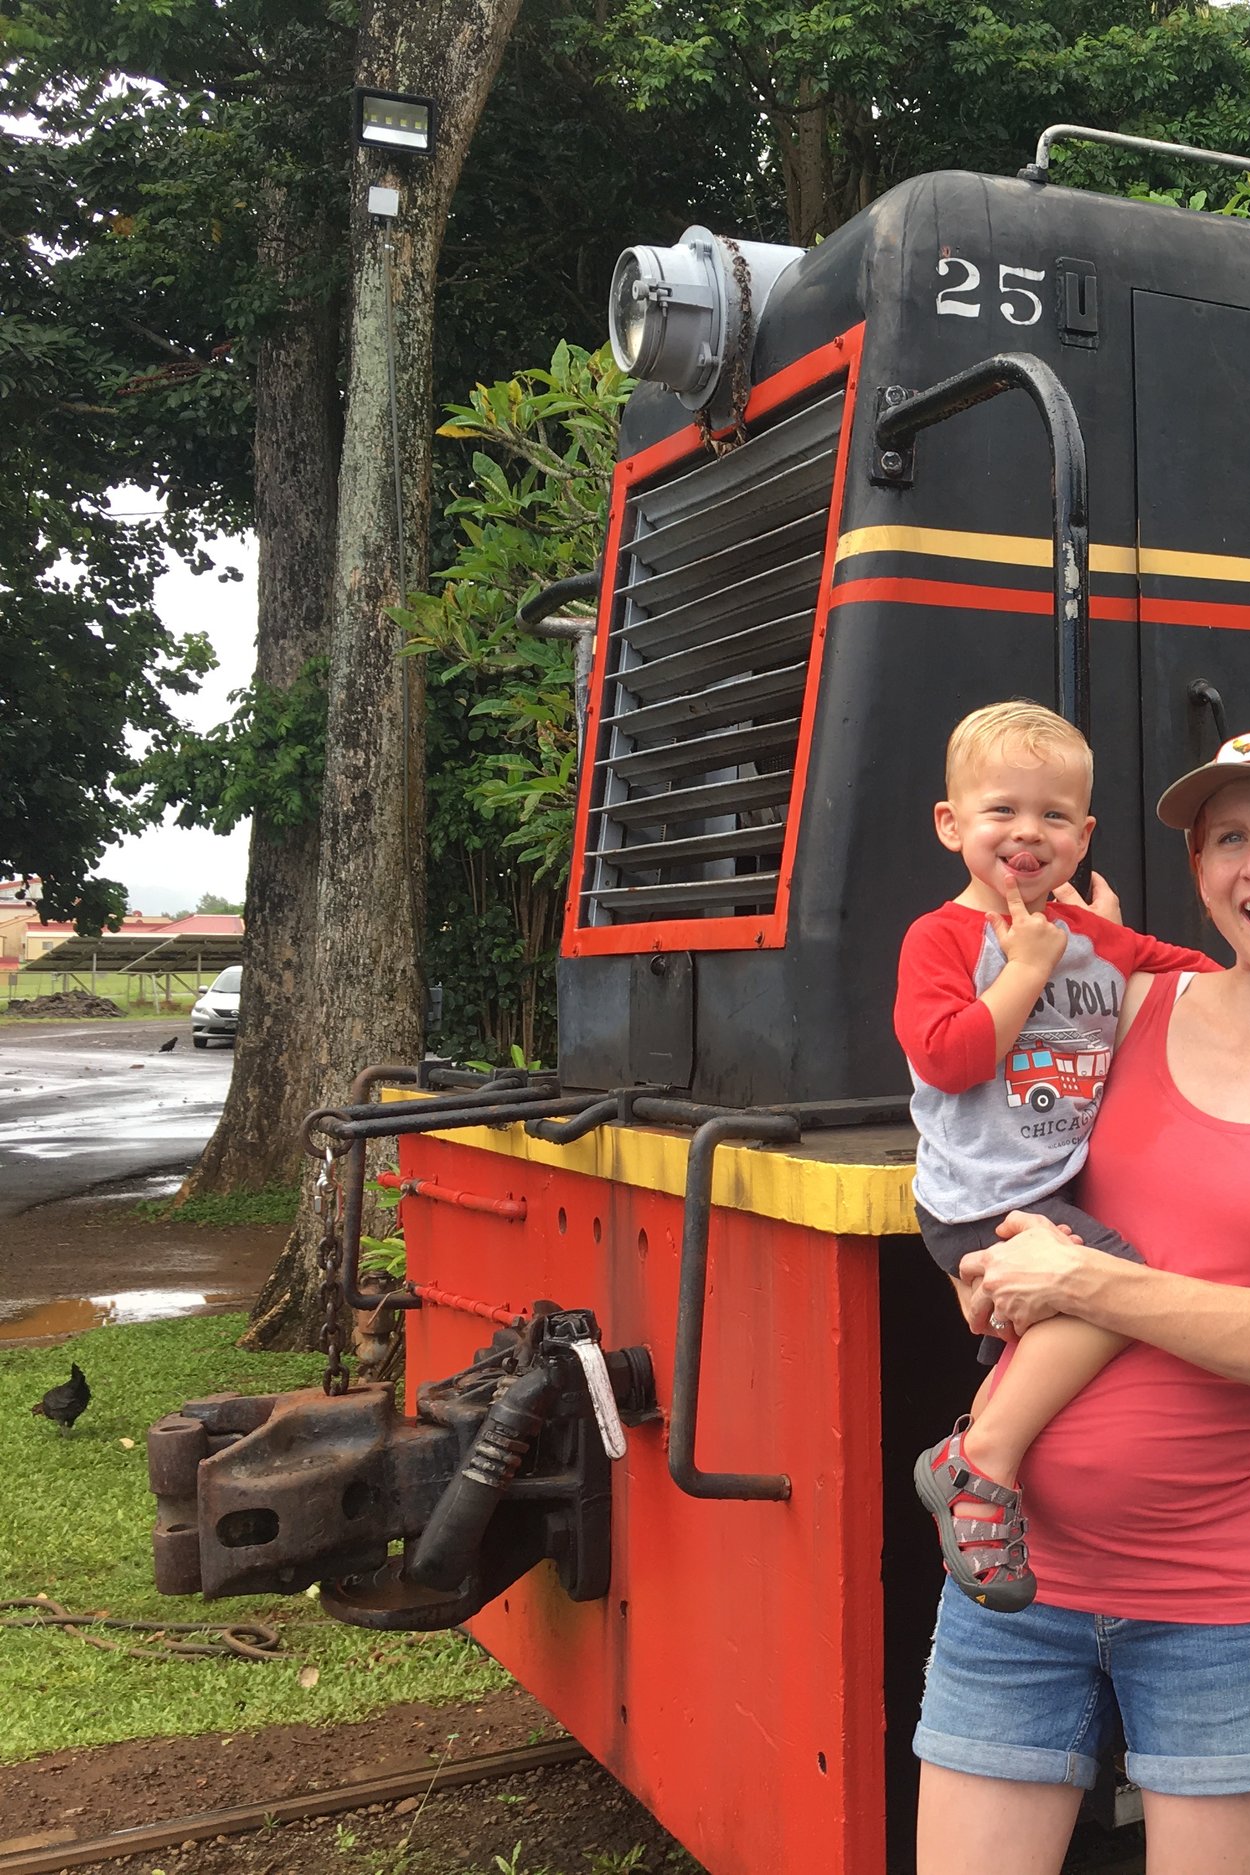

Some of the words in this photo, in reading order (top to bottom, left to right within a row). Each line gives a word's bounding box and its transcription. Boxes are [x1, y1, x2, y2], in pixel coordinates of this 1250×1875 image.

[936, 257, 1046, 326] 25
[1065, 977, 1120, 1018] ROLL
[1019, 1107, 1094, 1139] CHICAGO
